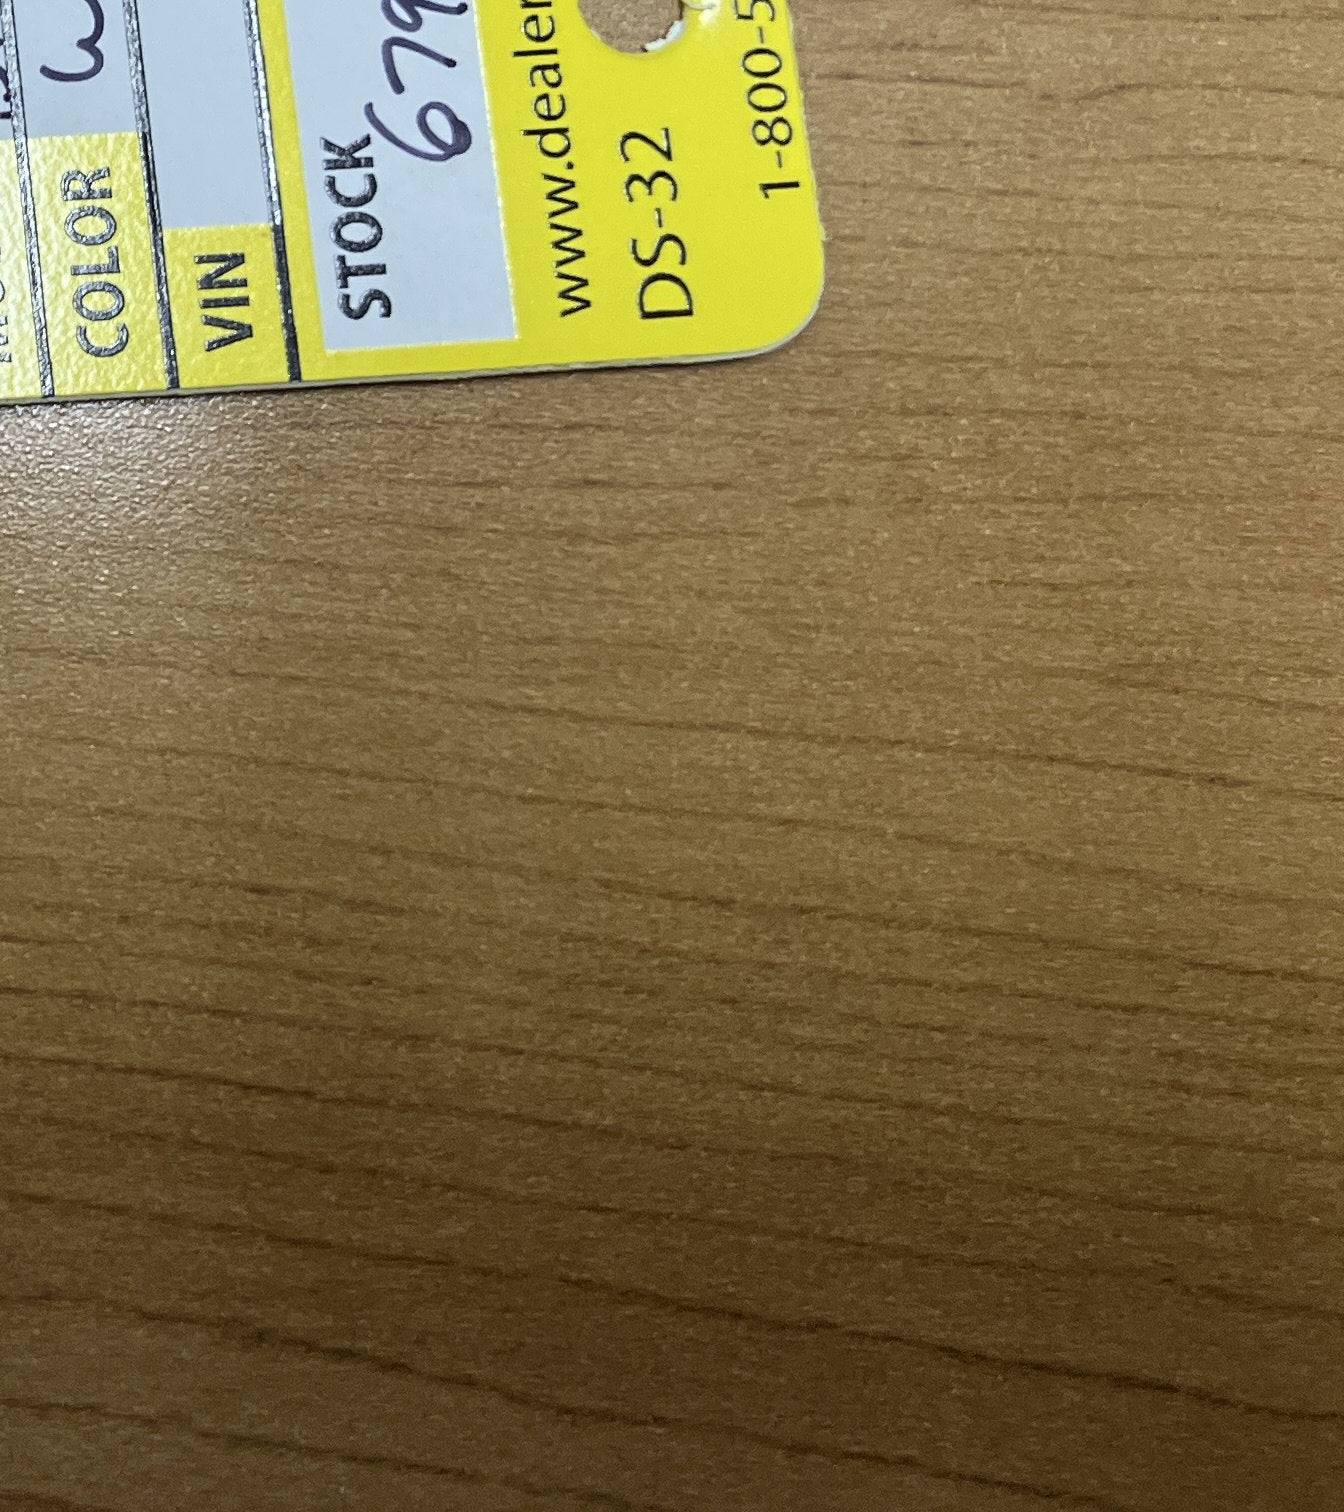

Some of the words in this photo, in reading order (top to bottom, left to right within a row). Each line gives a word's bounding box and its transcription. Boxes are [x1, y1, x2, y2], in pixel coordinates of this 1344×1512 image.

[62, 167, 130, 358] COLOR
[197, 251, 254, 352] VIN
[321, 134, 392, 322] STOCK
[619, 128, 694, 321] DS-32
